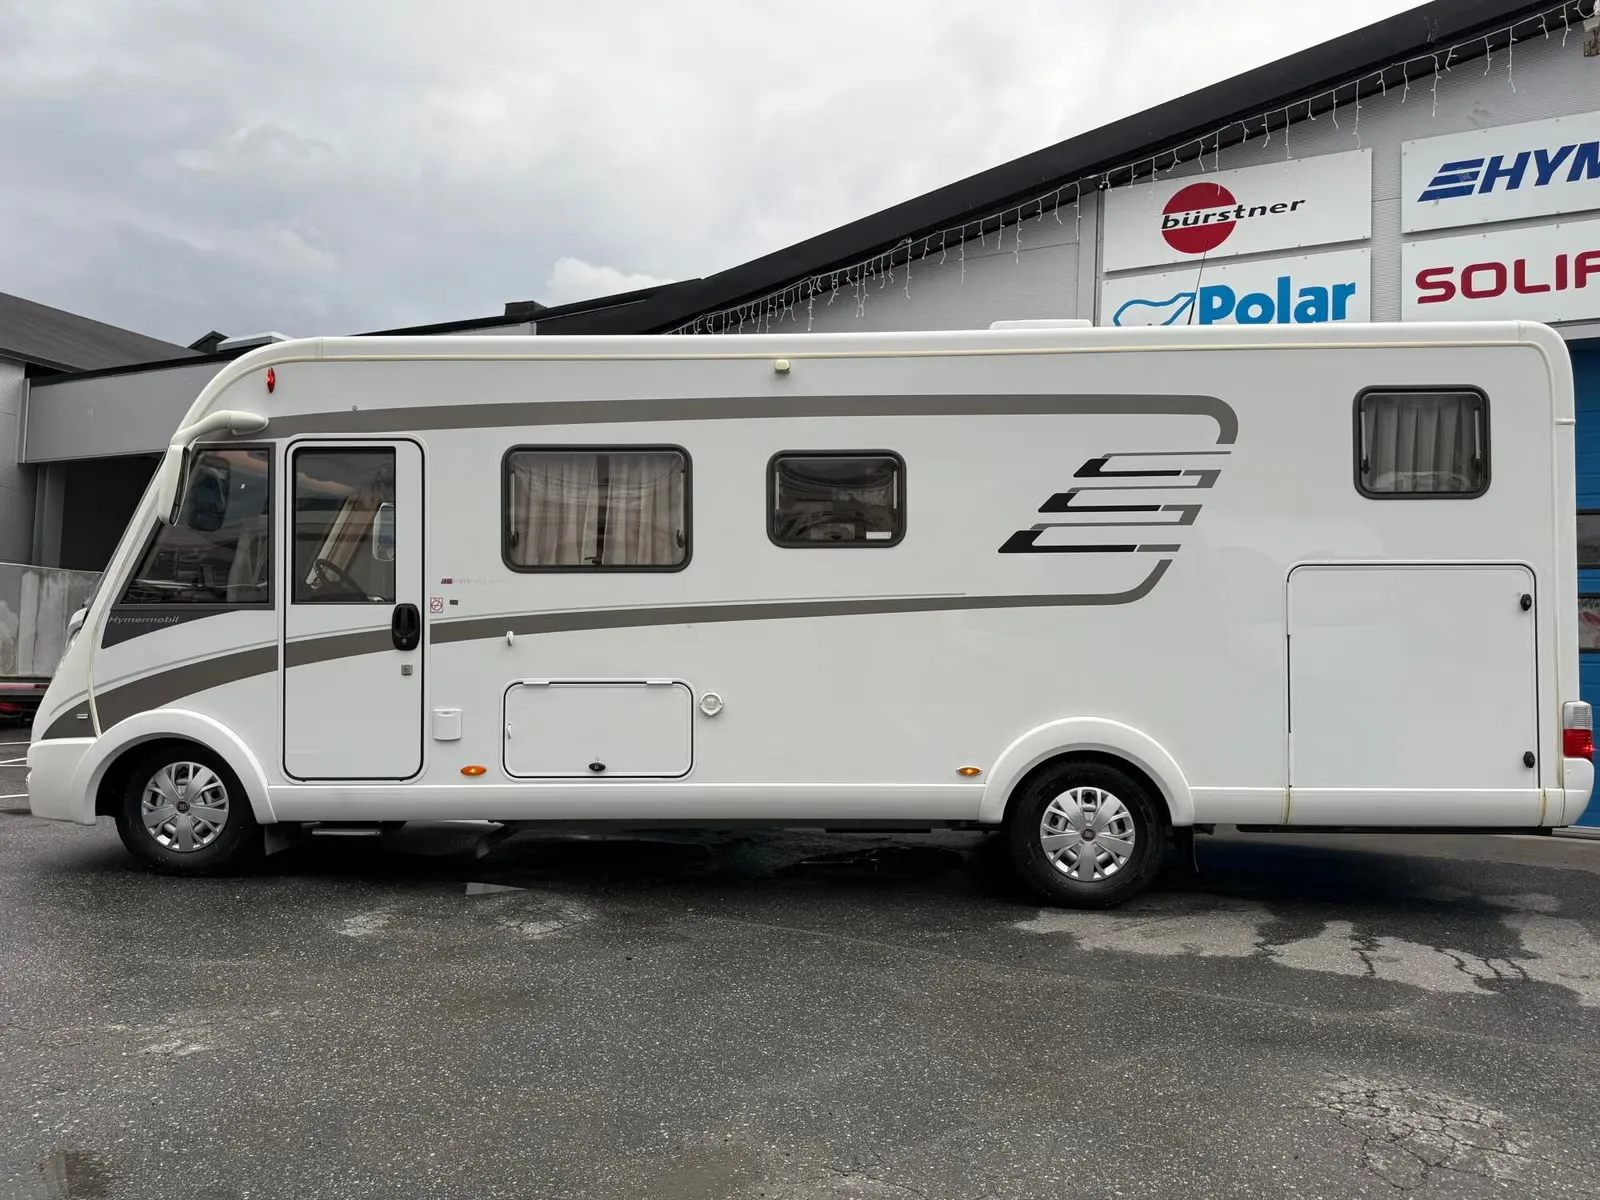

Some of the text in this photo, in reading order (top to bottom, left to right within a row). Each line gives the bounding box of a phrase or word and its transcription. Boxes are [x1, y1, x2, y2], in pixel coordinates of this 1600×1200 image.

[1161, 199, 1306, 230] bürstner
[1200, 276, 1356, 325] Polar
[108, 615, 180, 625] Hymermobil
